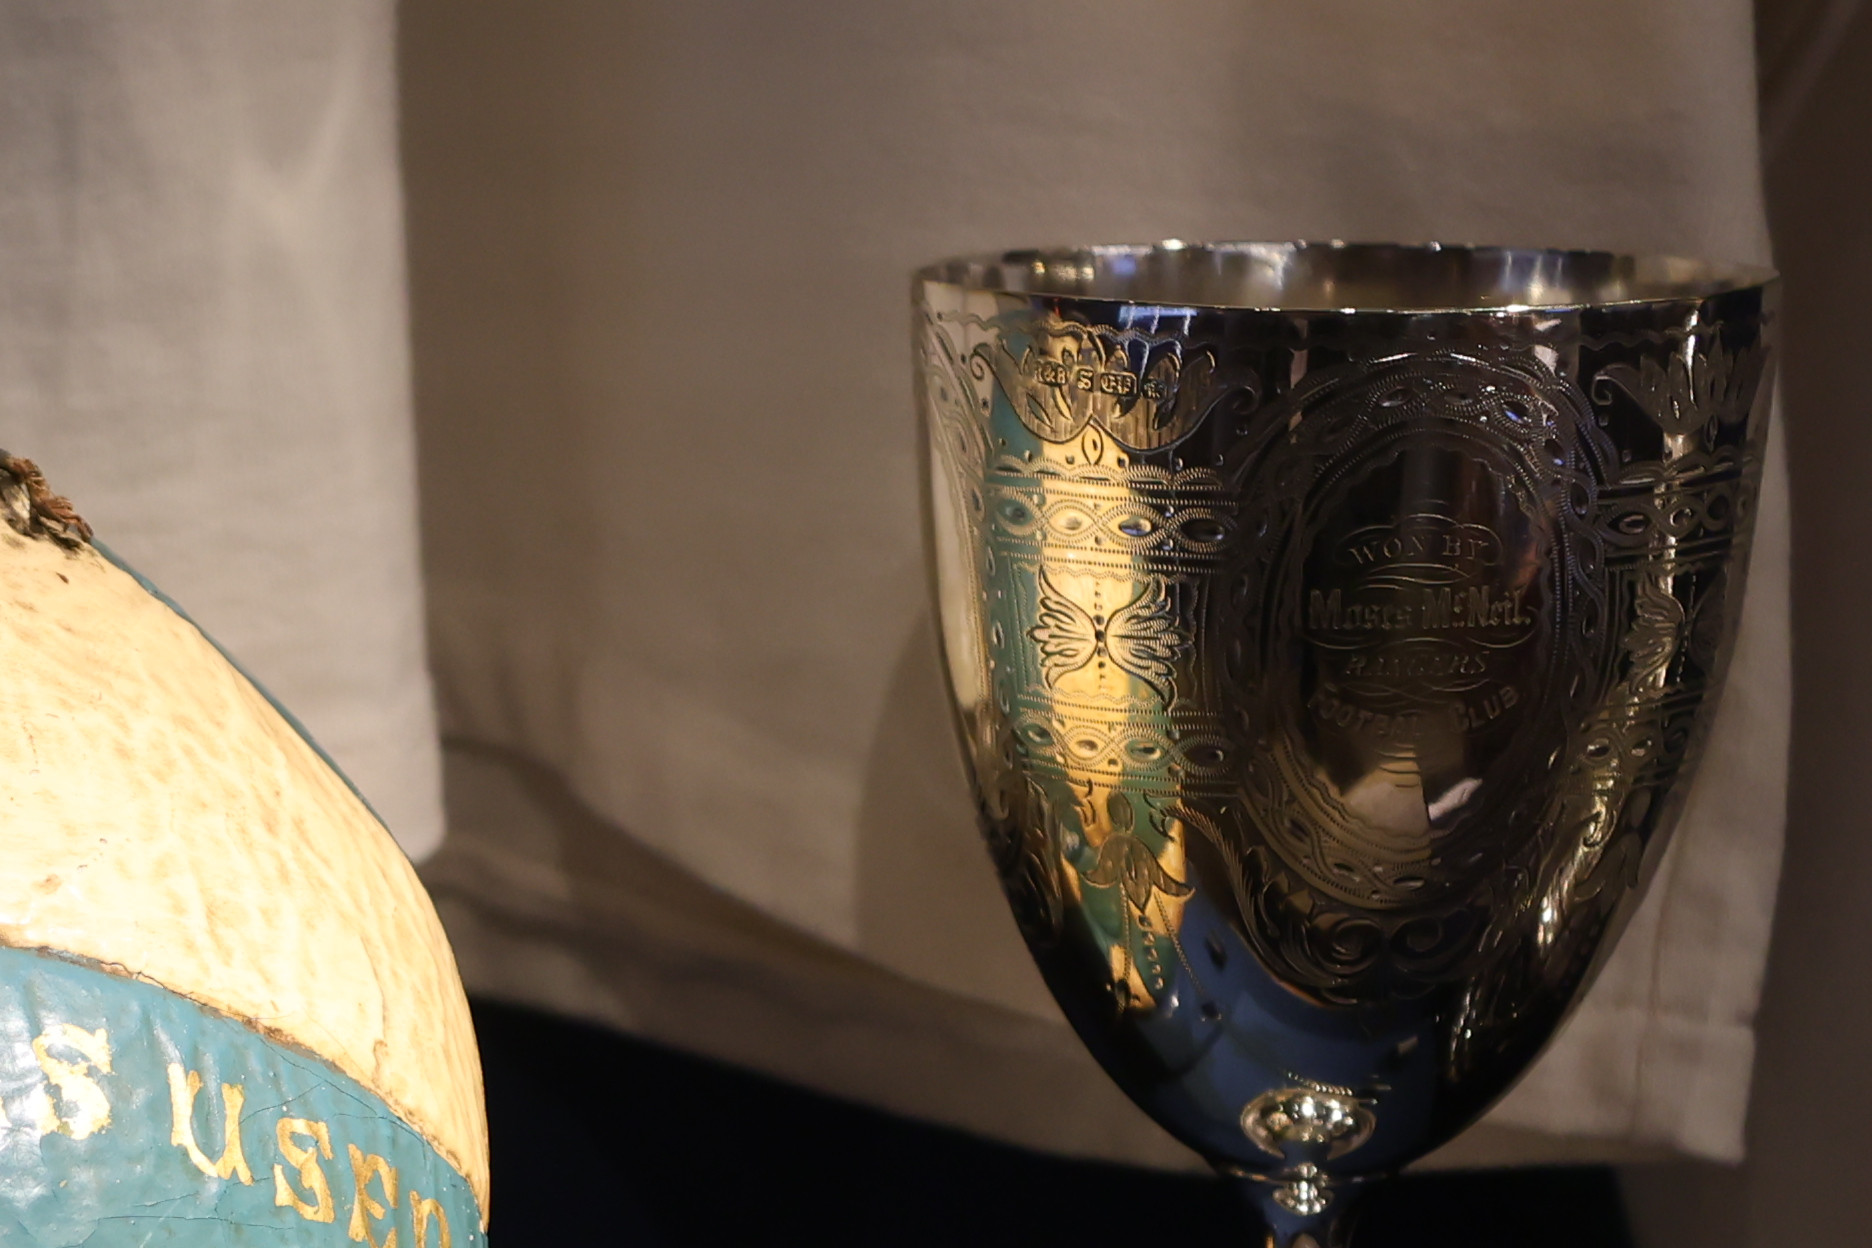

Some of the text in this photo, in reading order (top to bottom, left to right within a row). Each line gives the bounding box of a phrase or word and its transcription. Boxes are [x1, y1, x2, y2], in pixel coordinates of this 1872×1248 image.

[1347, 533, 1430, 565] WON
[1308, 587, 1413, 630] Moses
[1307, 681, 1520, 737] FOOTBAL CLUB
